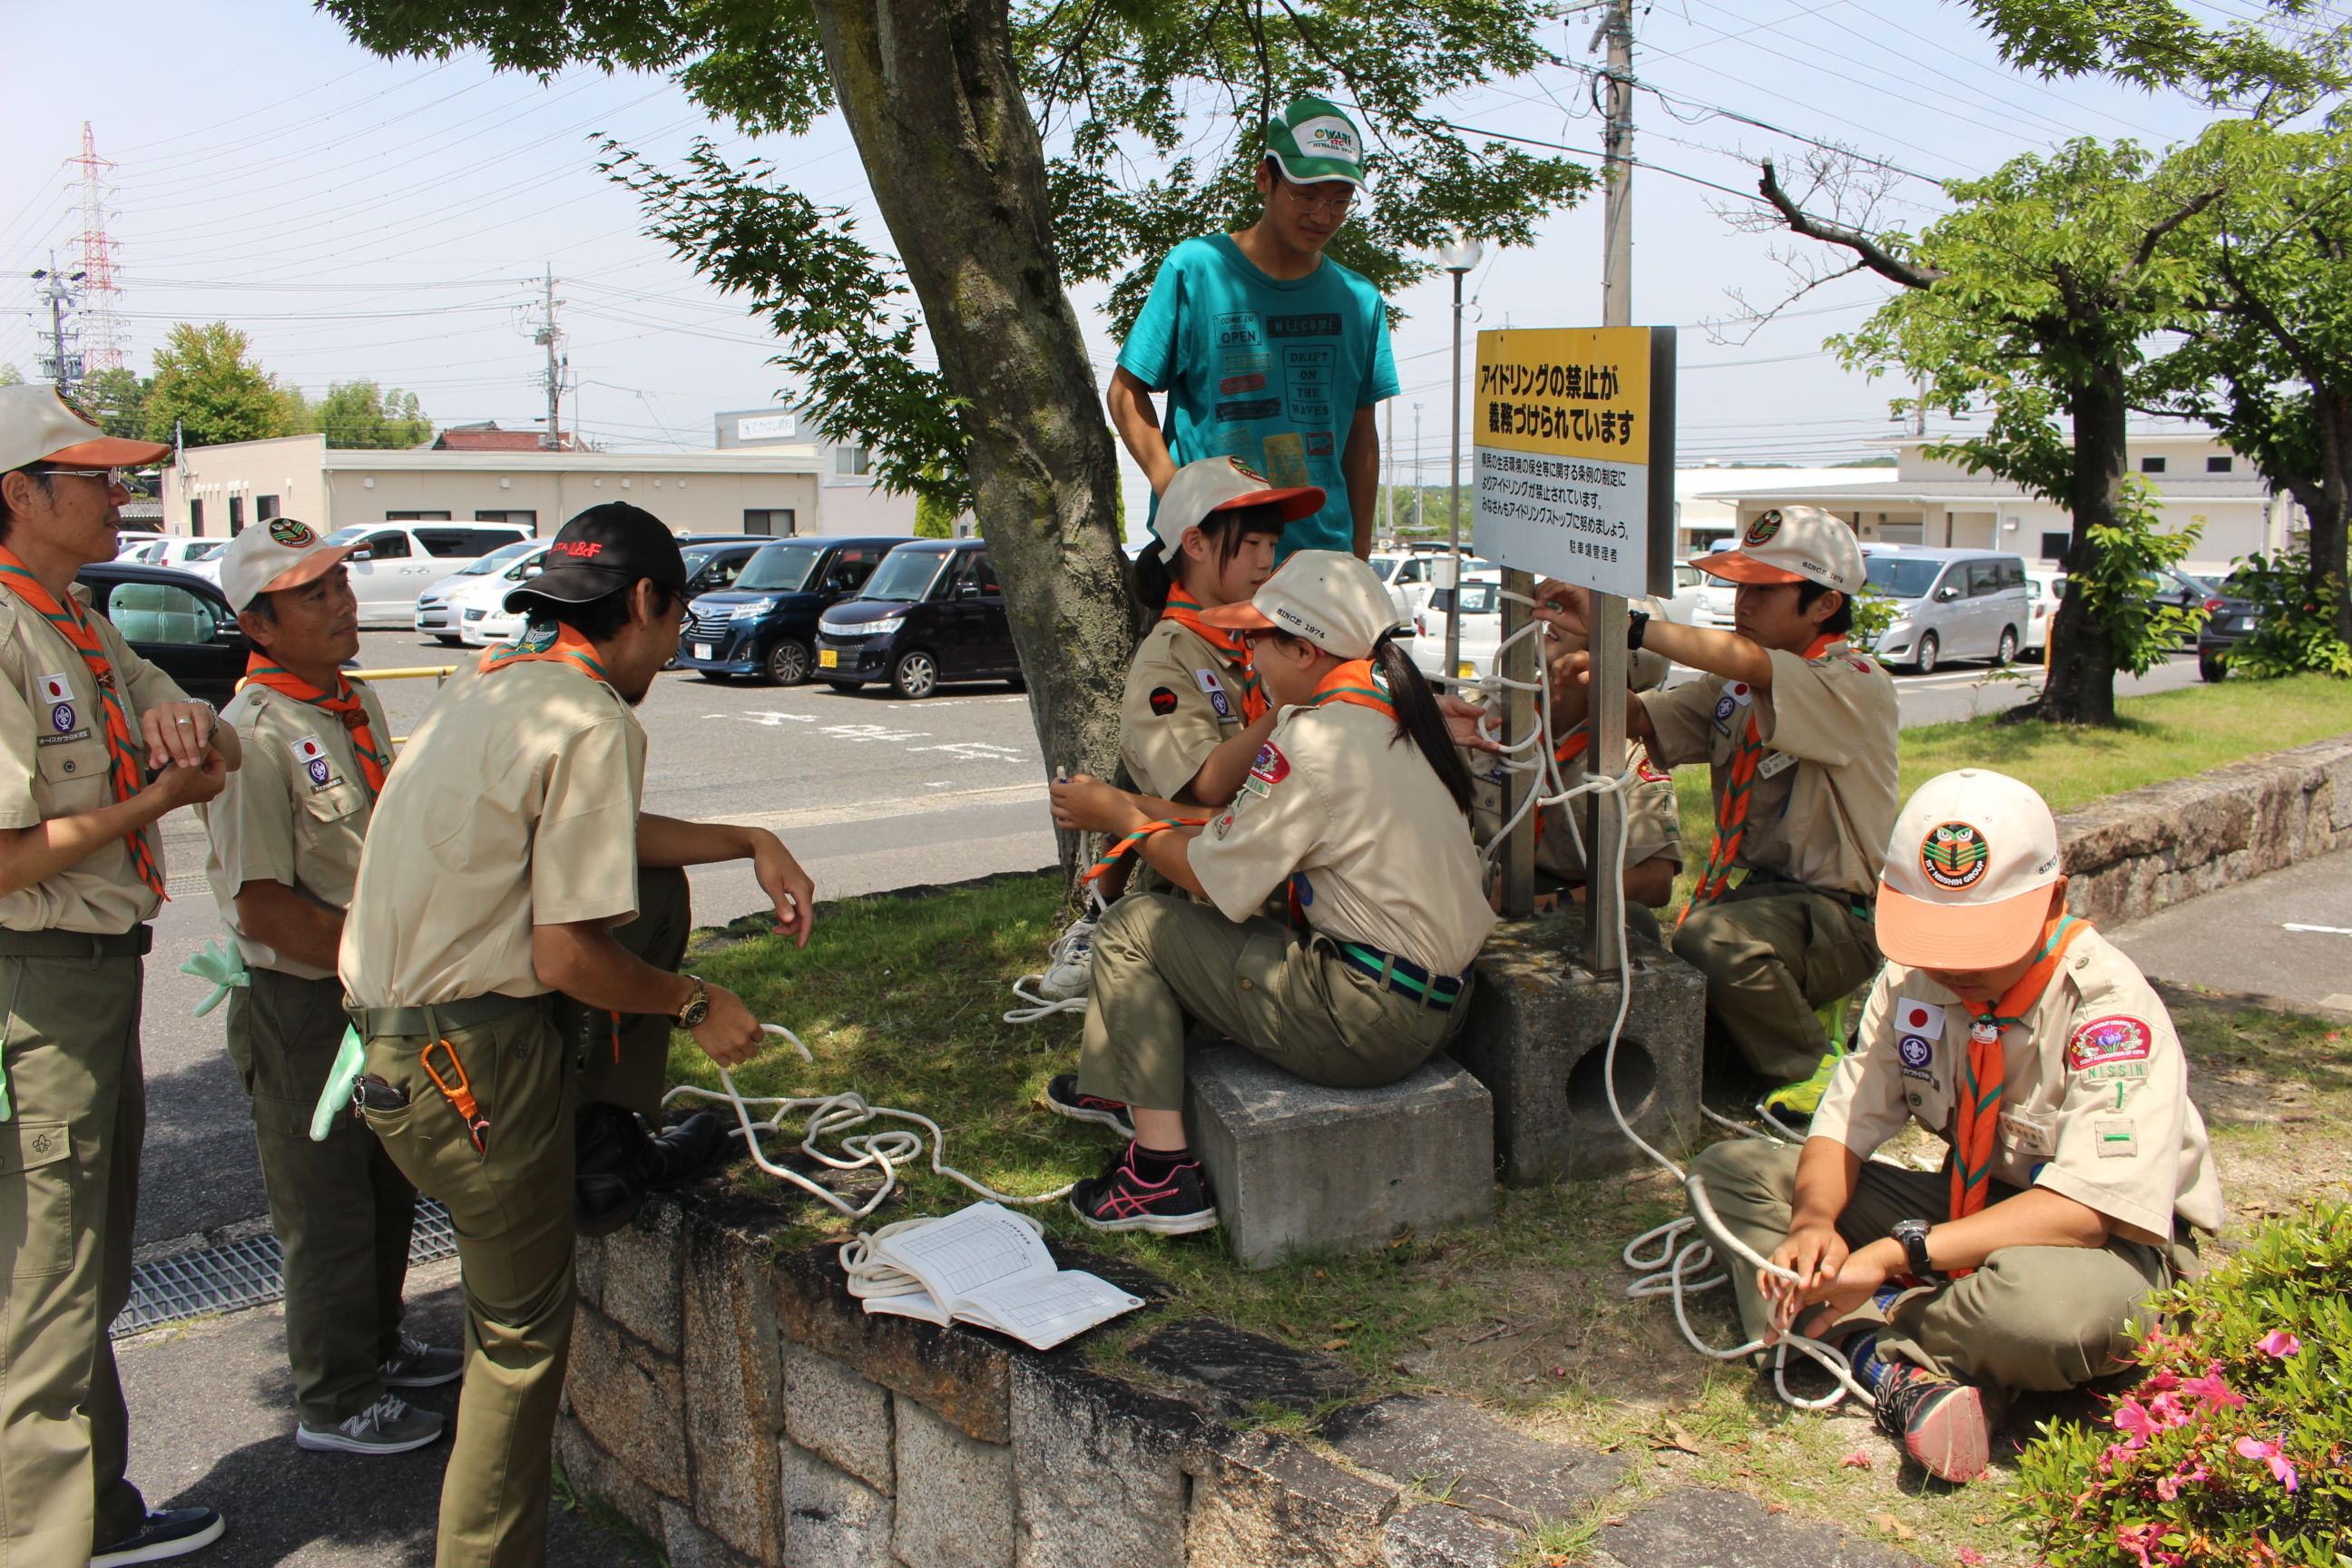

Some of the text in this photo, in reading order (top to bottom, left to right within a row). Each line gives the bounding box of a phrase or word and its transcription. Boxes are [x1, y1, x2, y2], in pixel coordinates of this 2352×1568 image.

[1220, 315, 1254, 325] COME IN
[1274, 318, 1335, 333] WELCOME
[1220, 330, 1257, 344] OPEN
[1290, 352, 1329, 363] DRIFT
[1299, 369, 1318, 380] ON
[1481, 363, 1619, 401] アイドリングの禁止が
[1297, 387, 1320, 398] THE
[1291, 404, 1330, 416] WAVES
[1488, 400, 1635, 446] 義務づけられています
[1481, 452, 1627, 487] 県民の生活環境の保全等に関する条例の制定に
[566, 541, 603, 558] L&F
[1802, 562, 1828, 576] SINCE
[1277, 608, 1326, 639] SINCE 1974
[1925, 858, 1984, 886] 1ST NISSHIN GROUP
[2088, 1063, 2143, 1079] NISSIN
